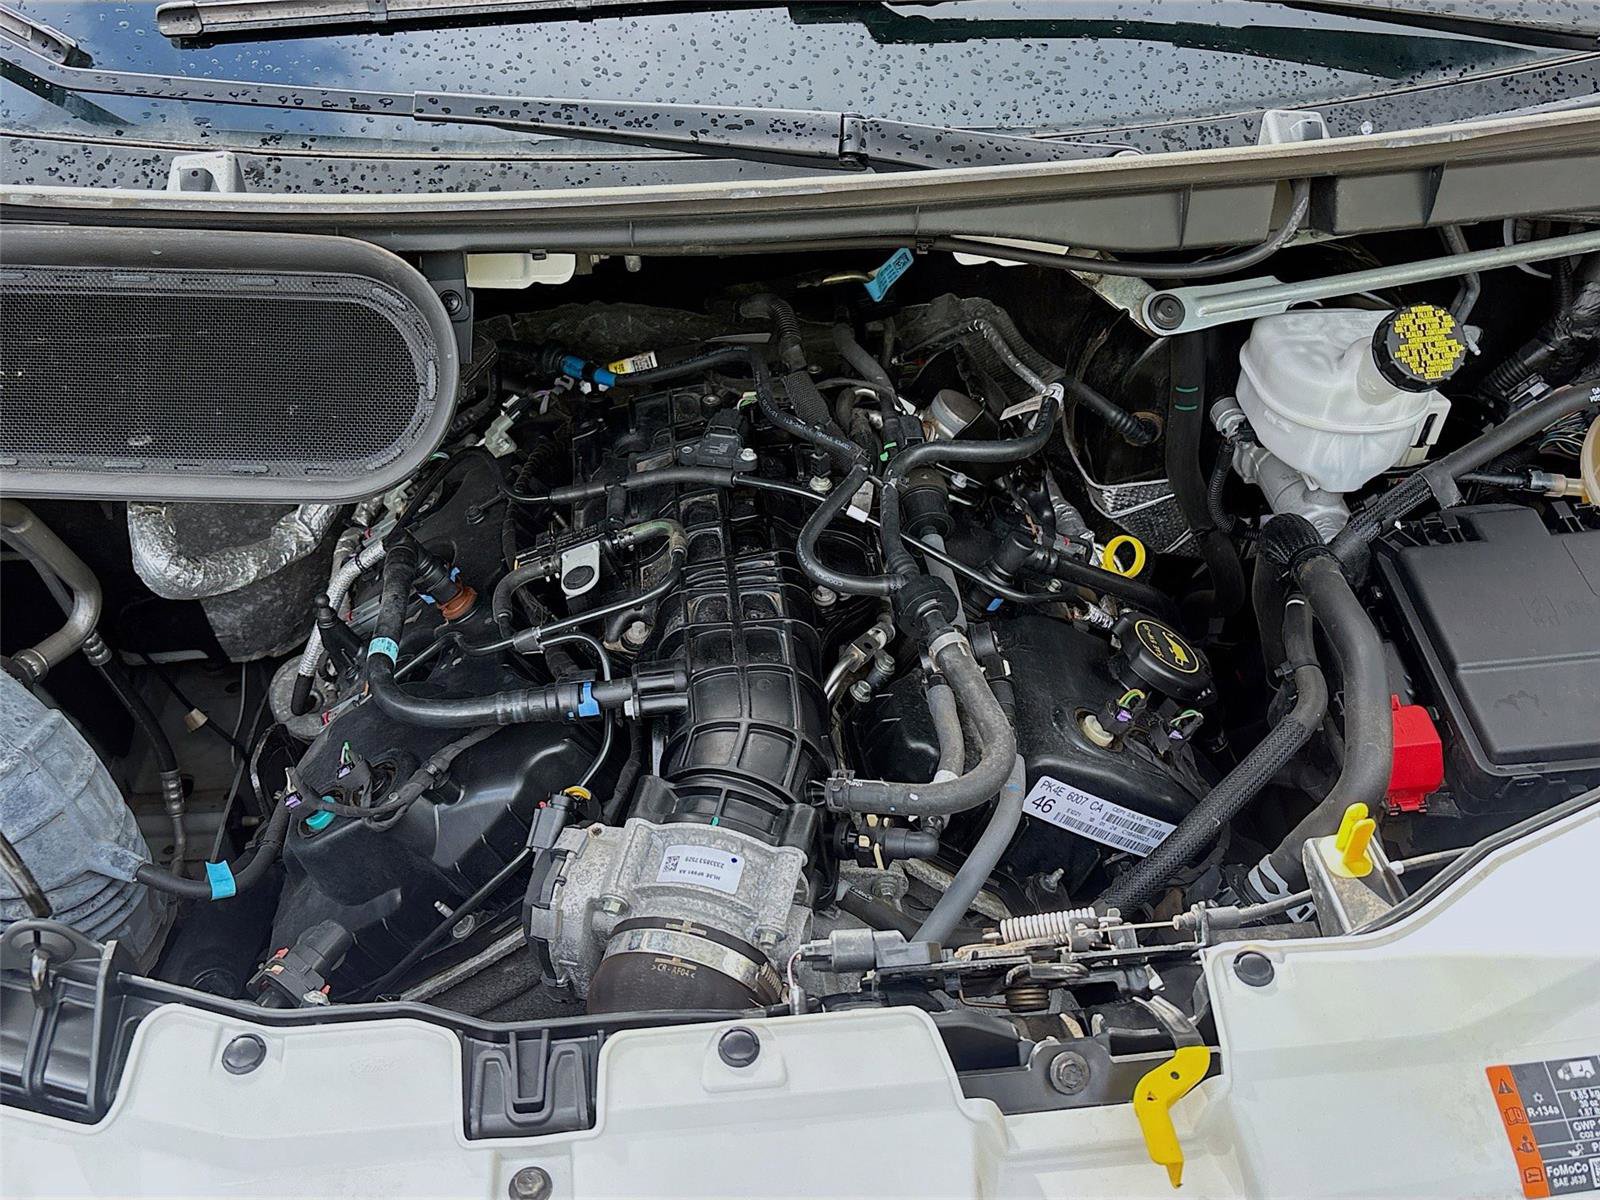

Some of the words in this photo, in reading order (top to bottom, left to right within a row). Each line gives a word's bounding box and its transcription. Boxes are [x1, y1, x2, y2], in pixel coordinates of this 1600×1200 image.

[1040, 780, 1066, 797] PK4E
[1067, 792, 1089, 805] 6007
[1089, 801, 1104, 813] CA
[1032, 795, 1056, 813] 46
[1527, 1105, 1560, 1118] R-134a
[1573, 1119, 1596, 1131] GWP
[1545, 1162, 1589, 1177] FoMoCo
[1553, 1177, 1569, 1188] SAE
